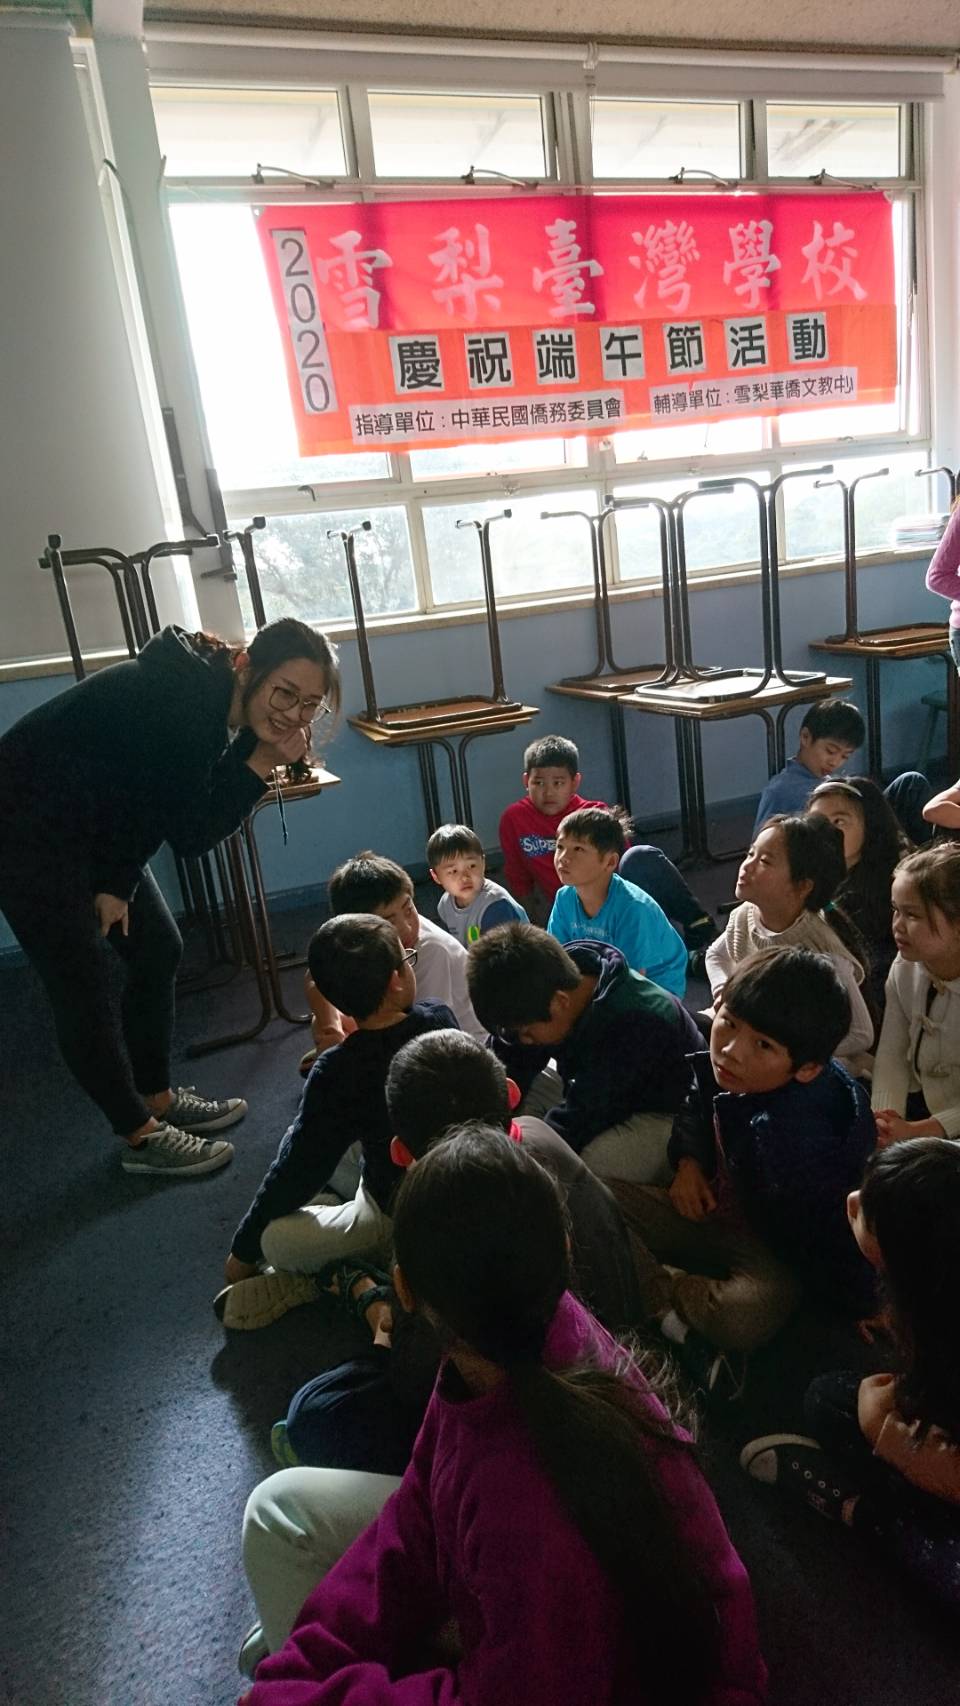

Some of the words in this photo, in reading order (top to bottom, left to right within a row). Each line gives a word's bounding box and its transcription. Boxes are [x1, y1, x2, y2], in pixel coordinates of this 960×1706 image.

[280, 237, 331, 413] 2020
[316, 218, 868, 330] 雪梨臺灣學校
[396, 318, 827, 390] 慶祝端午節活動
